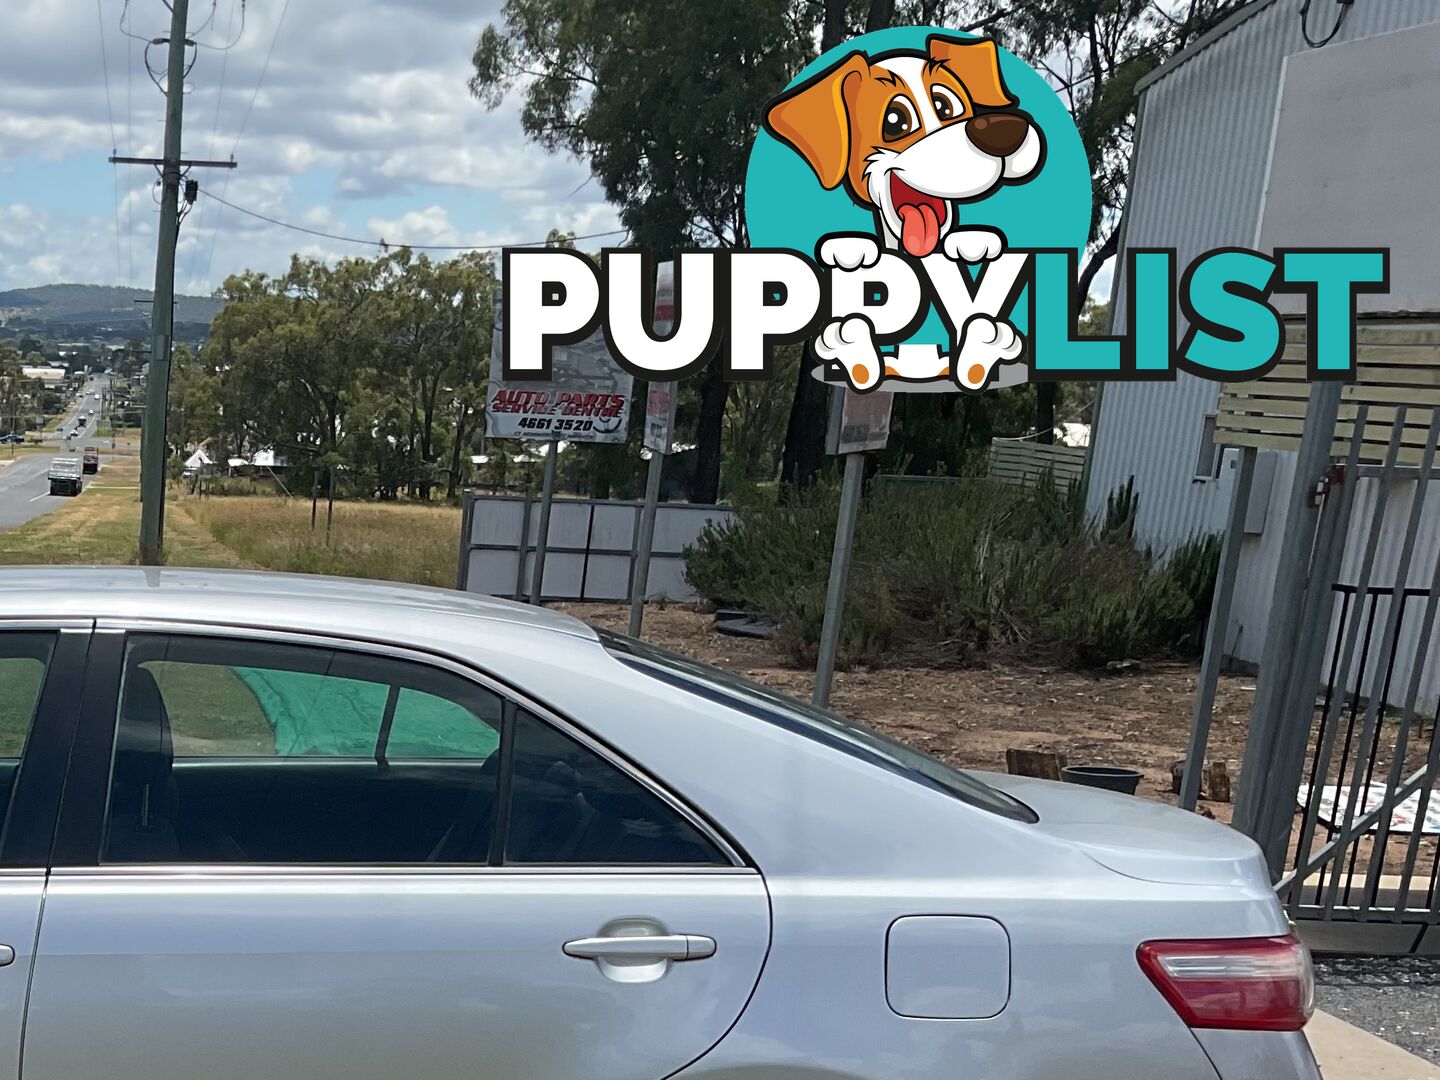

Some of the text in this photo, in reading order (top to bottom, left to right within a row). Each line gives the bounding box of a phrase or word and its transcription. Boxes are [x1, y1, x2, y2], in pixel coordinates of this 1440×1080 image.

[491, 389, 625, 408] AUTO PARTS
[491, 403, 623, 417] SERVICE CENTRE
[518, 418, 593, 431] 4661 3520
